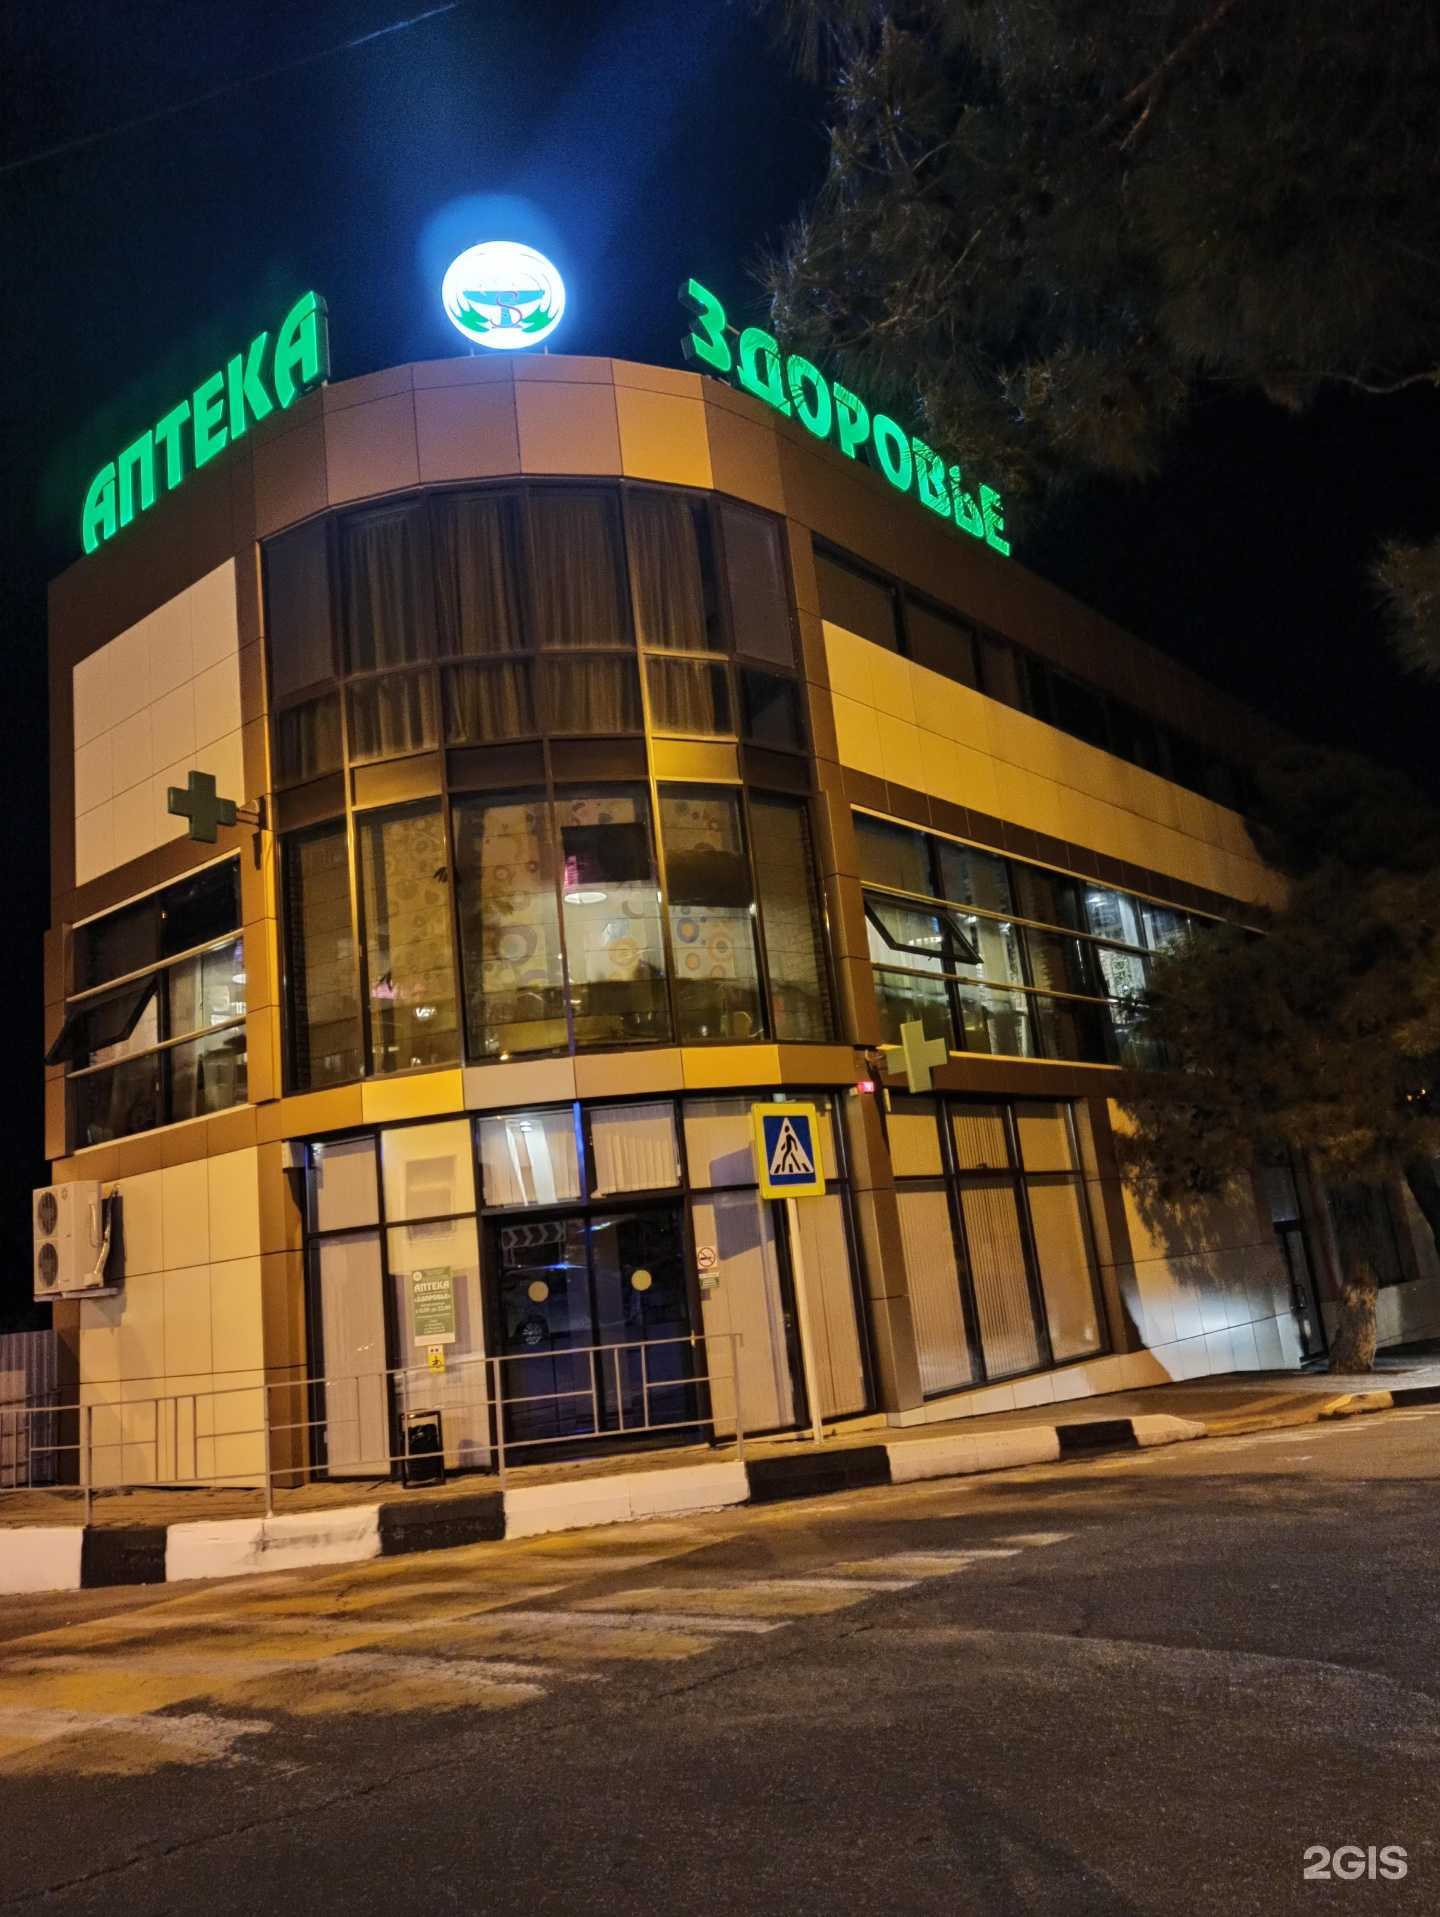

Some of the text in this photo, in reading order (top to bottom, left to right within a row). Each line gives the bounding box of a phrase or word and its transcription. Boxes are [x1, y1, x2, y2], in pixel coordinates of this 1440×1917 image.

[81, 289, 325, 555] АПТЕКА
[687, 277, 1012, 558] ЗДОРОВЬЕ
[414, 1280, 450, 1293] АПТЕКА
